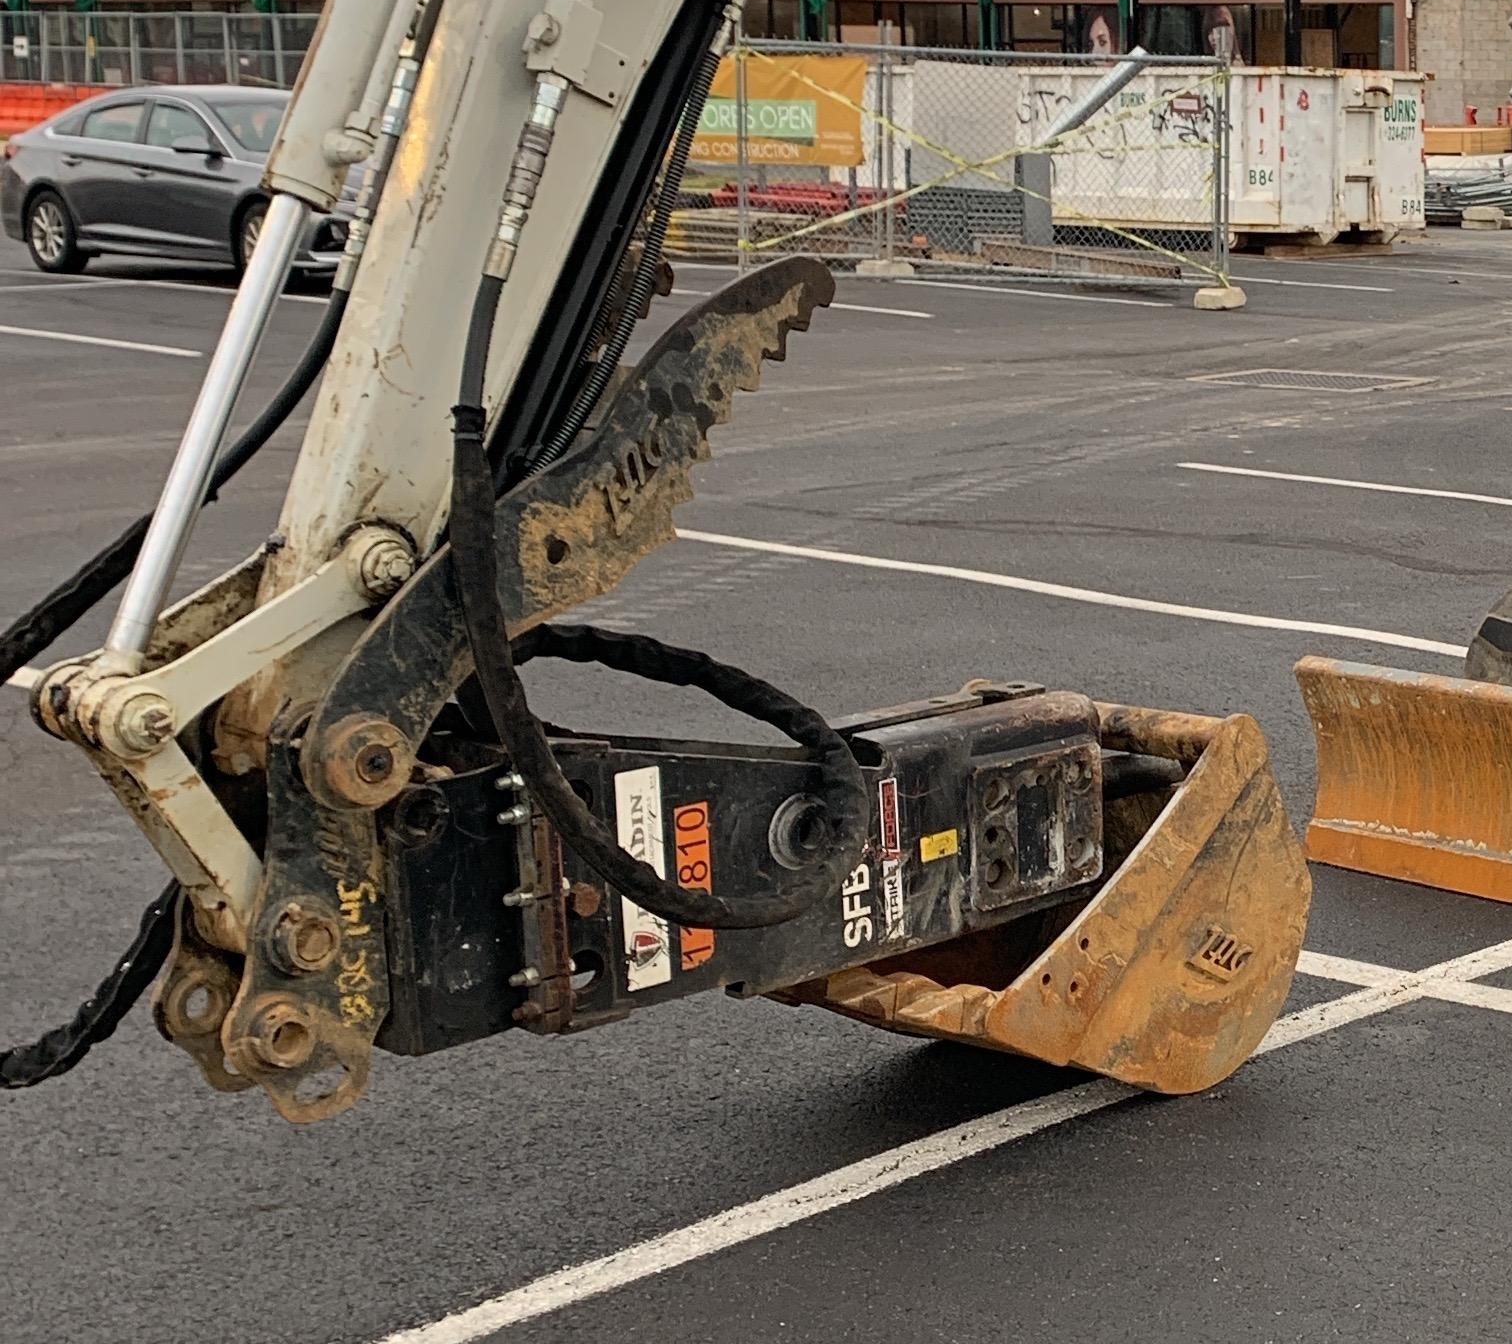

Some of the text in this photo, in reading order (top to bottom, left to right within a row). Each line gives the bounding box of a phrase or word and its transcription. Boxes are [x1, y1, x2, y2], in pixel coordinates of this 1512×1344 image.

[760, 105, 813, 129] OPEN
[1384, 99, 1417, 122] BURNS
[1402, 199, 1422, 216] B84
[676, 806, 711, 962] 1810
[841, 862, 873, 948] SFB
